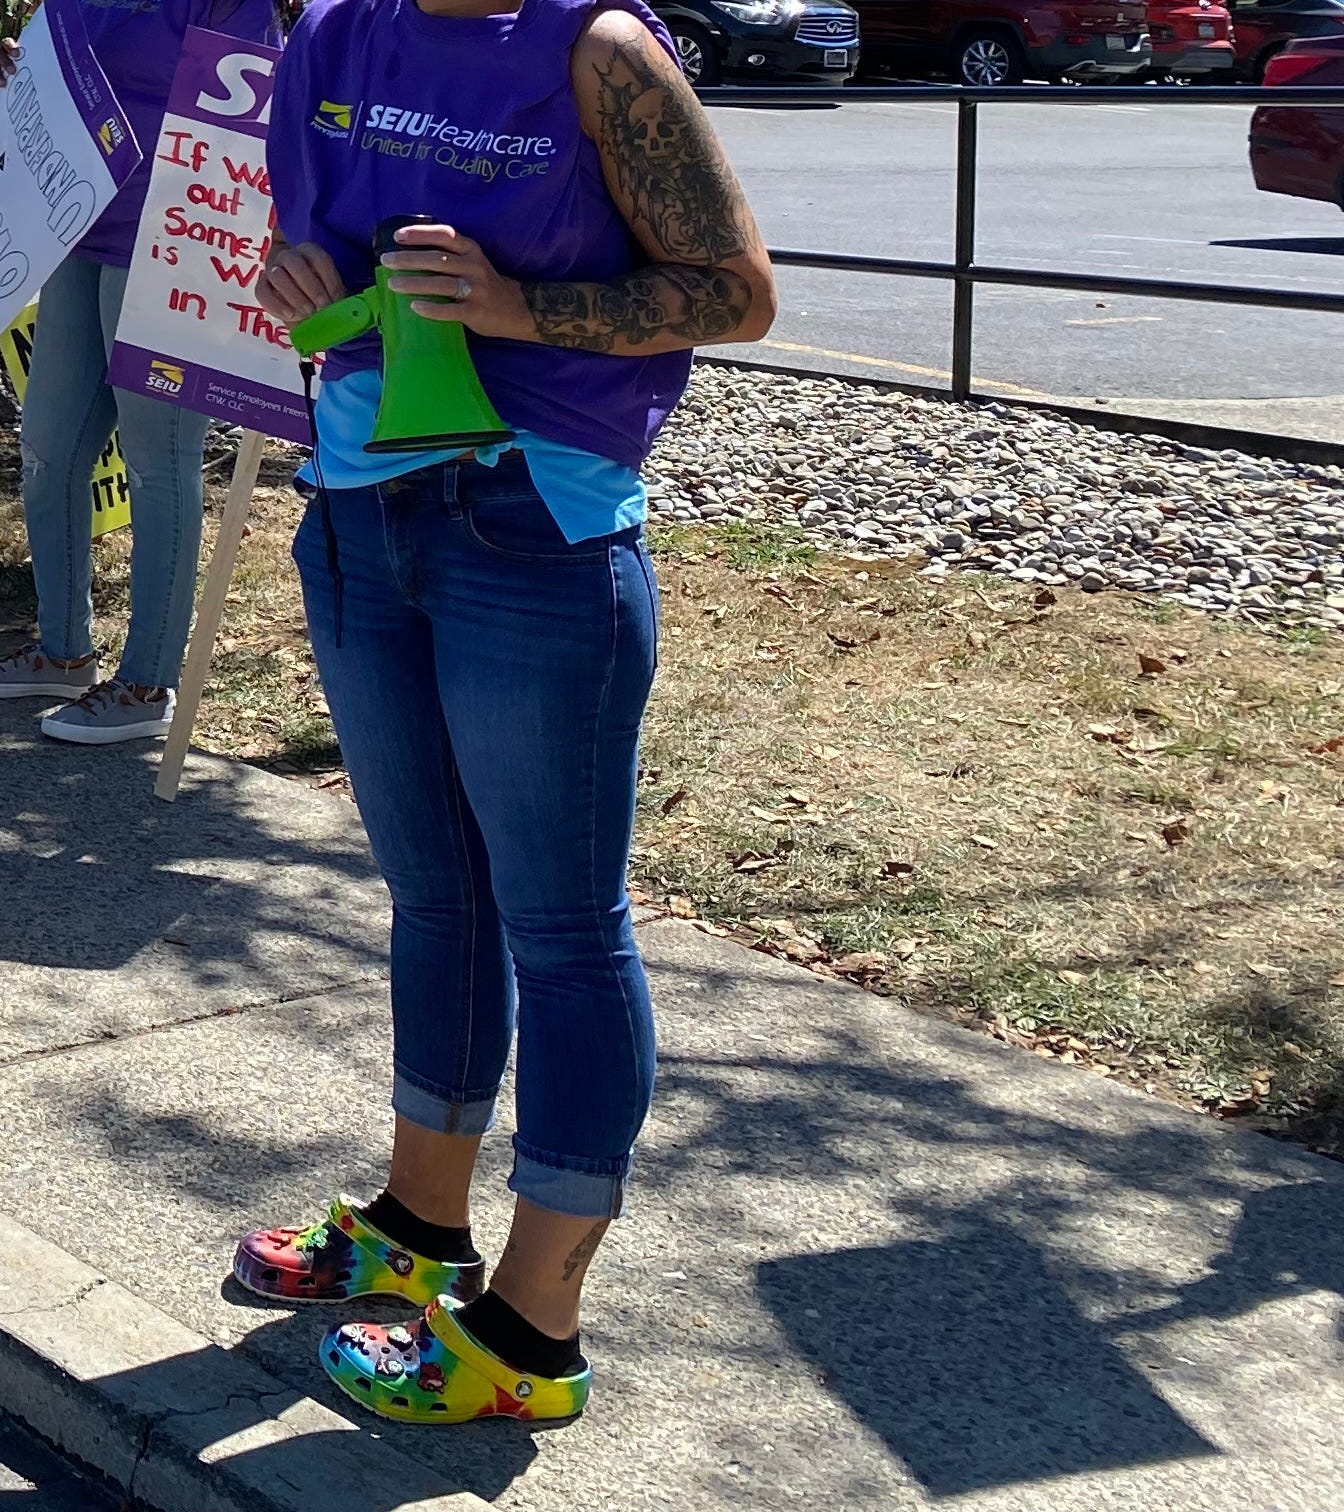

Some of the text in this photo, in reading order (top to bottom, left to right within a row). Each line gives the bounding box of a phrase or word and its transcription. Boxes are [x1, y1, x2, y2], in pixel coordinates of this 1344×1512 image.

[104, 117, 125, 144] SEIU
[157, 130, 210, 173] If
[362, 132, 413, 159] United
[435, 146, 501, 183] Quality
[506, 159, 550, 180] Care
[187, 184, 245, 215] out
[165, 206, 270, 262] Somet
[152, 245, 179, 265] is
[145, 375, 181, 393] SEIU
[208, 382, 237, 398] Service
[238, 392, 282, 412] Employees
[228, 401, 245, 412] CLC
